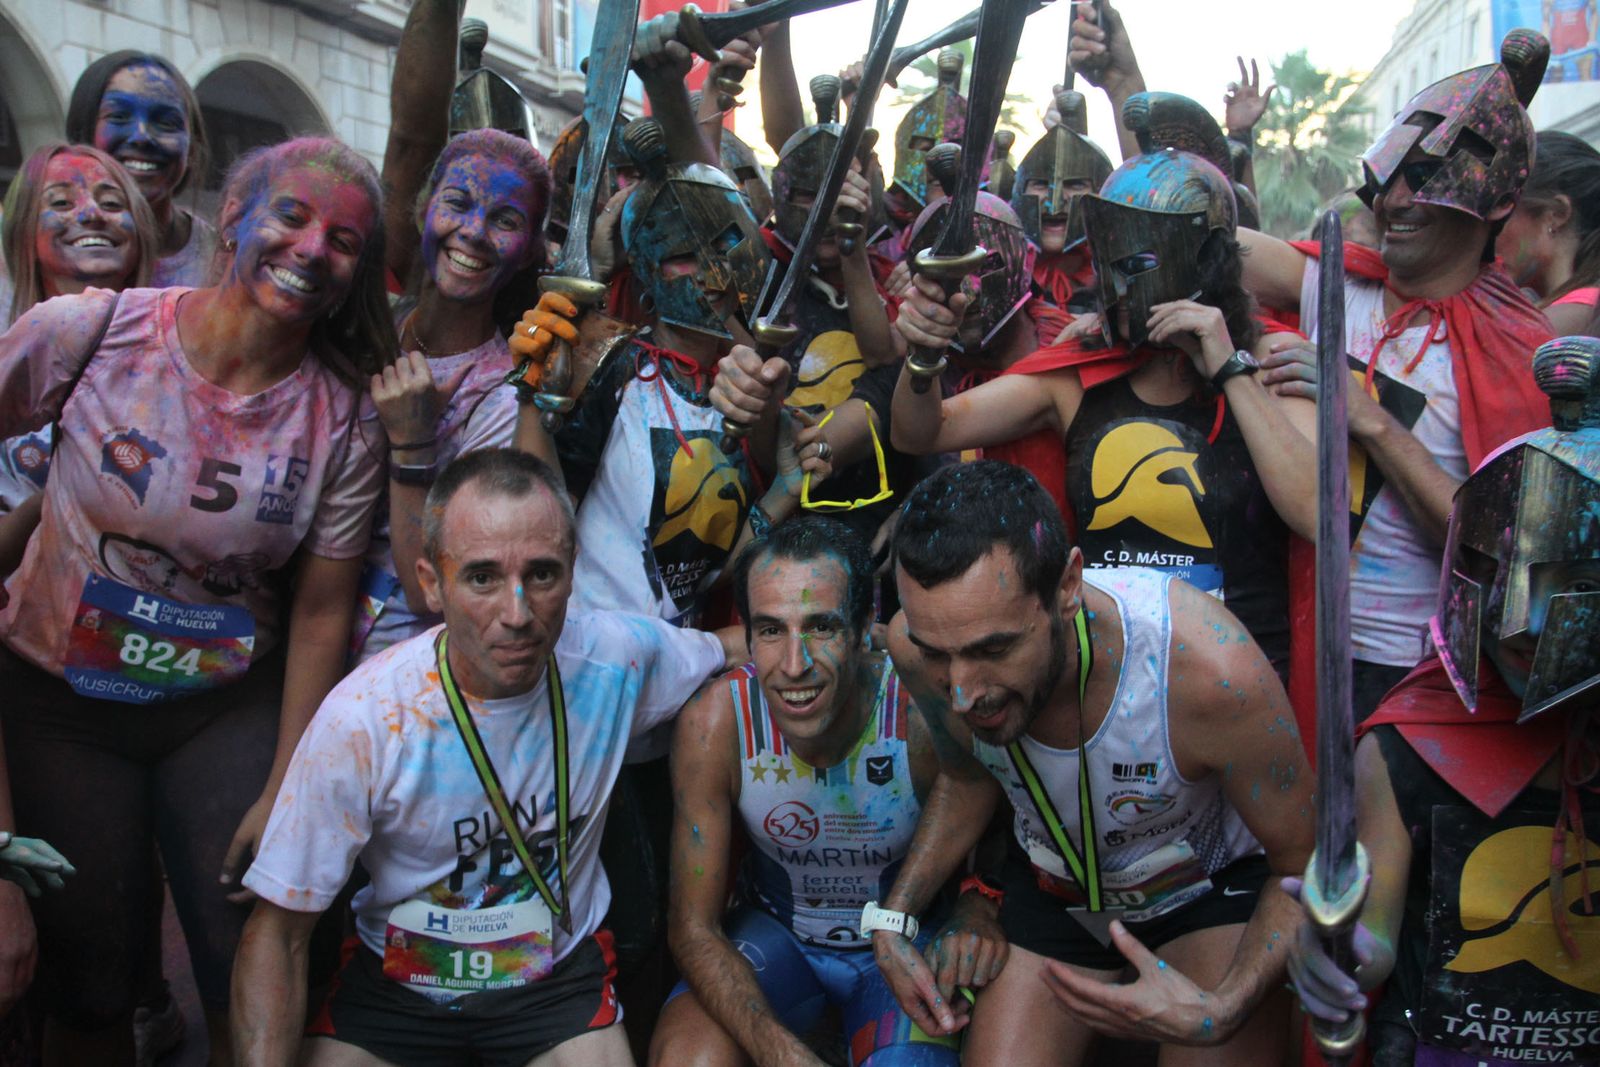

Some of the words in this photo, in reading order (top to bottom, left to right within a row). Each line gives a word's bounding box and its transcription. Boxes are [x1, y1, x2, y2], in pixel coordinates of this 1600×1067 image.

[190, 457, 242, 513] 5
[263, 456, 308, 499] 15
[1136, 551, 1194, 566] MÁSTER
[161, 603, 225, 620] DIPUTACIÓN
[159, 612, 173, 623] DE
[175, 617, 218, 630] HUELVA
[119, 633, 202, 677] 824
[776, 844, 893, 867] MARTÍN
[802, 874, 864, 885] ferrer
[802, 885, 869, 896] hotels
[452, 911, 514, 924] DIPUTACIÓN
[452, 925, 466, 933] DE
[468, 921, 508, 933] HUELVA
[448, 950, 493, 980] 19
[410, 973, 443, 986] DANIEL
[445, 978, 484, 990] AGUIRRE
[1466, 1003, 1486, 1019] C.
[1493, 1007, 1516, 1022] D.
[1492, 1046, 1574, 1063] HUELVA
